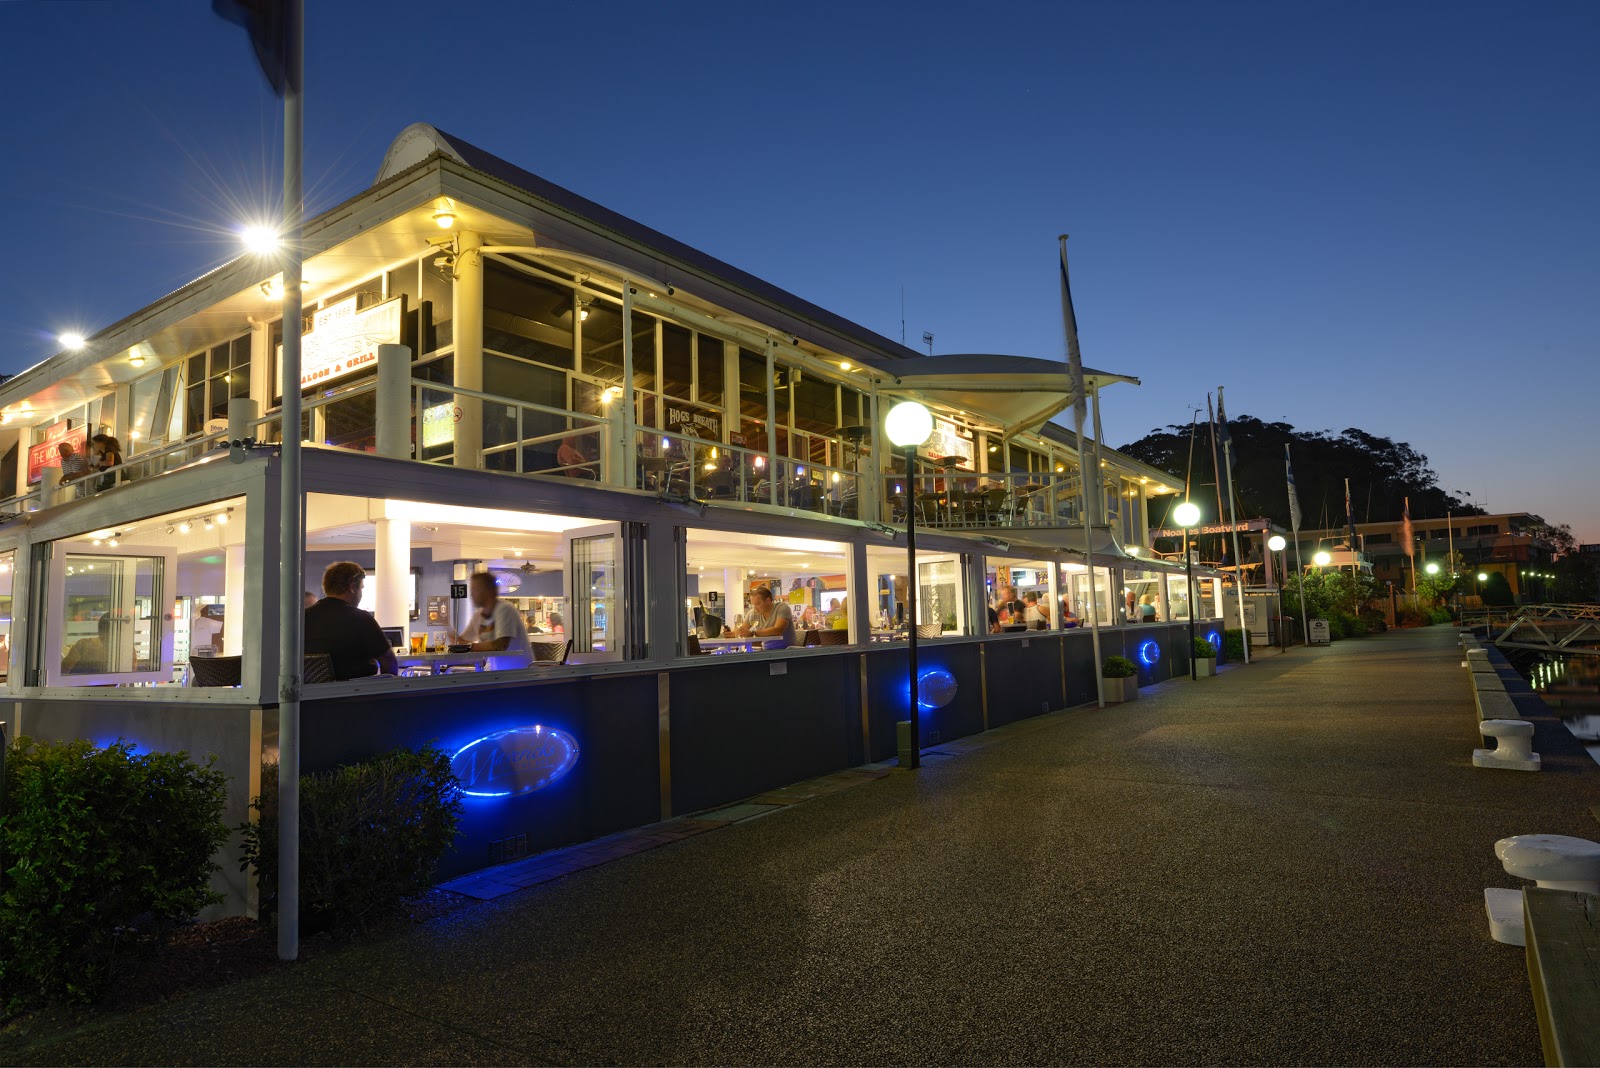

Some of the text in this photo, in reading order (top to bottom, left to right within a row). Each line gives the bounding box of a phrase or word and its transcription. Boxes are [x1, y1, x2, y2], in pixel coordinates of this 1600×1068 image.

[318, 313, 332, 326] EST
[301, 352, 376, 384] ALOON & GRILL
[34, 450, 45, 465] THE
[45, 444, 61, 461] WOO
[1201, 522, 1249, 535] Boatyrd
[453, 586, 465, 597] 15
[711, 592, 716, 601] 5
